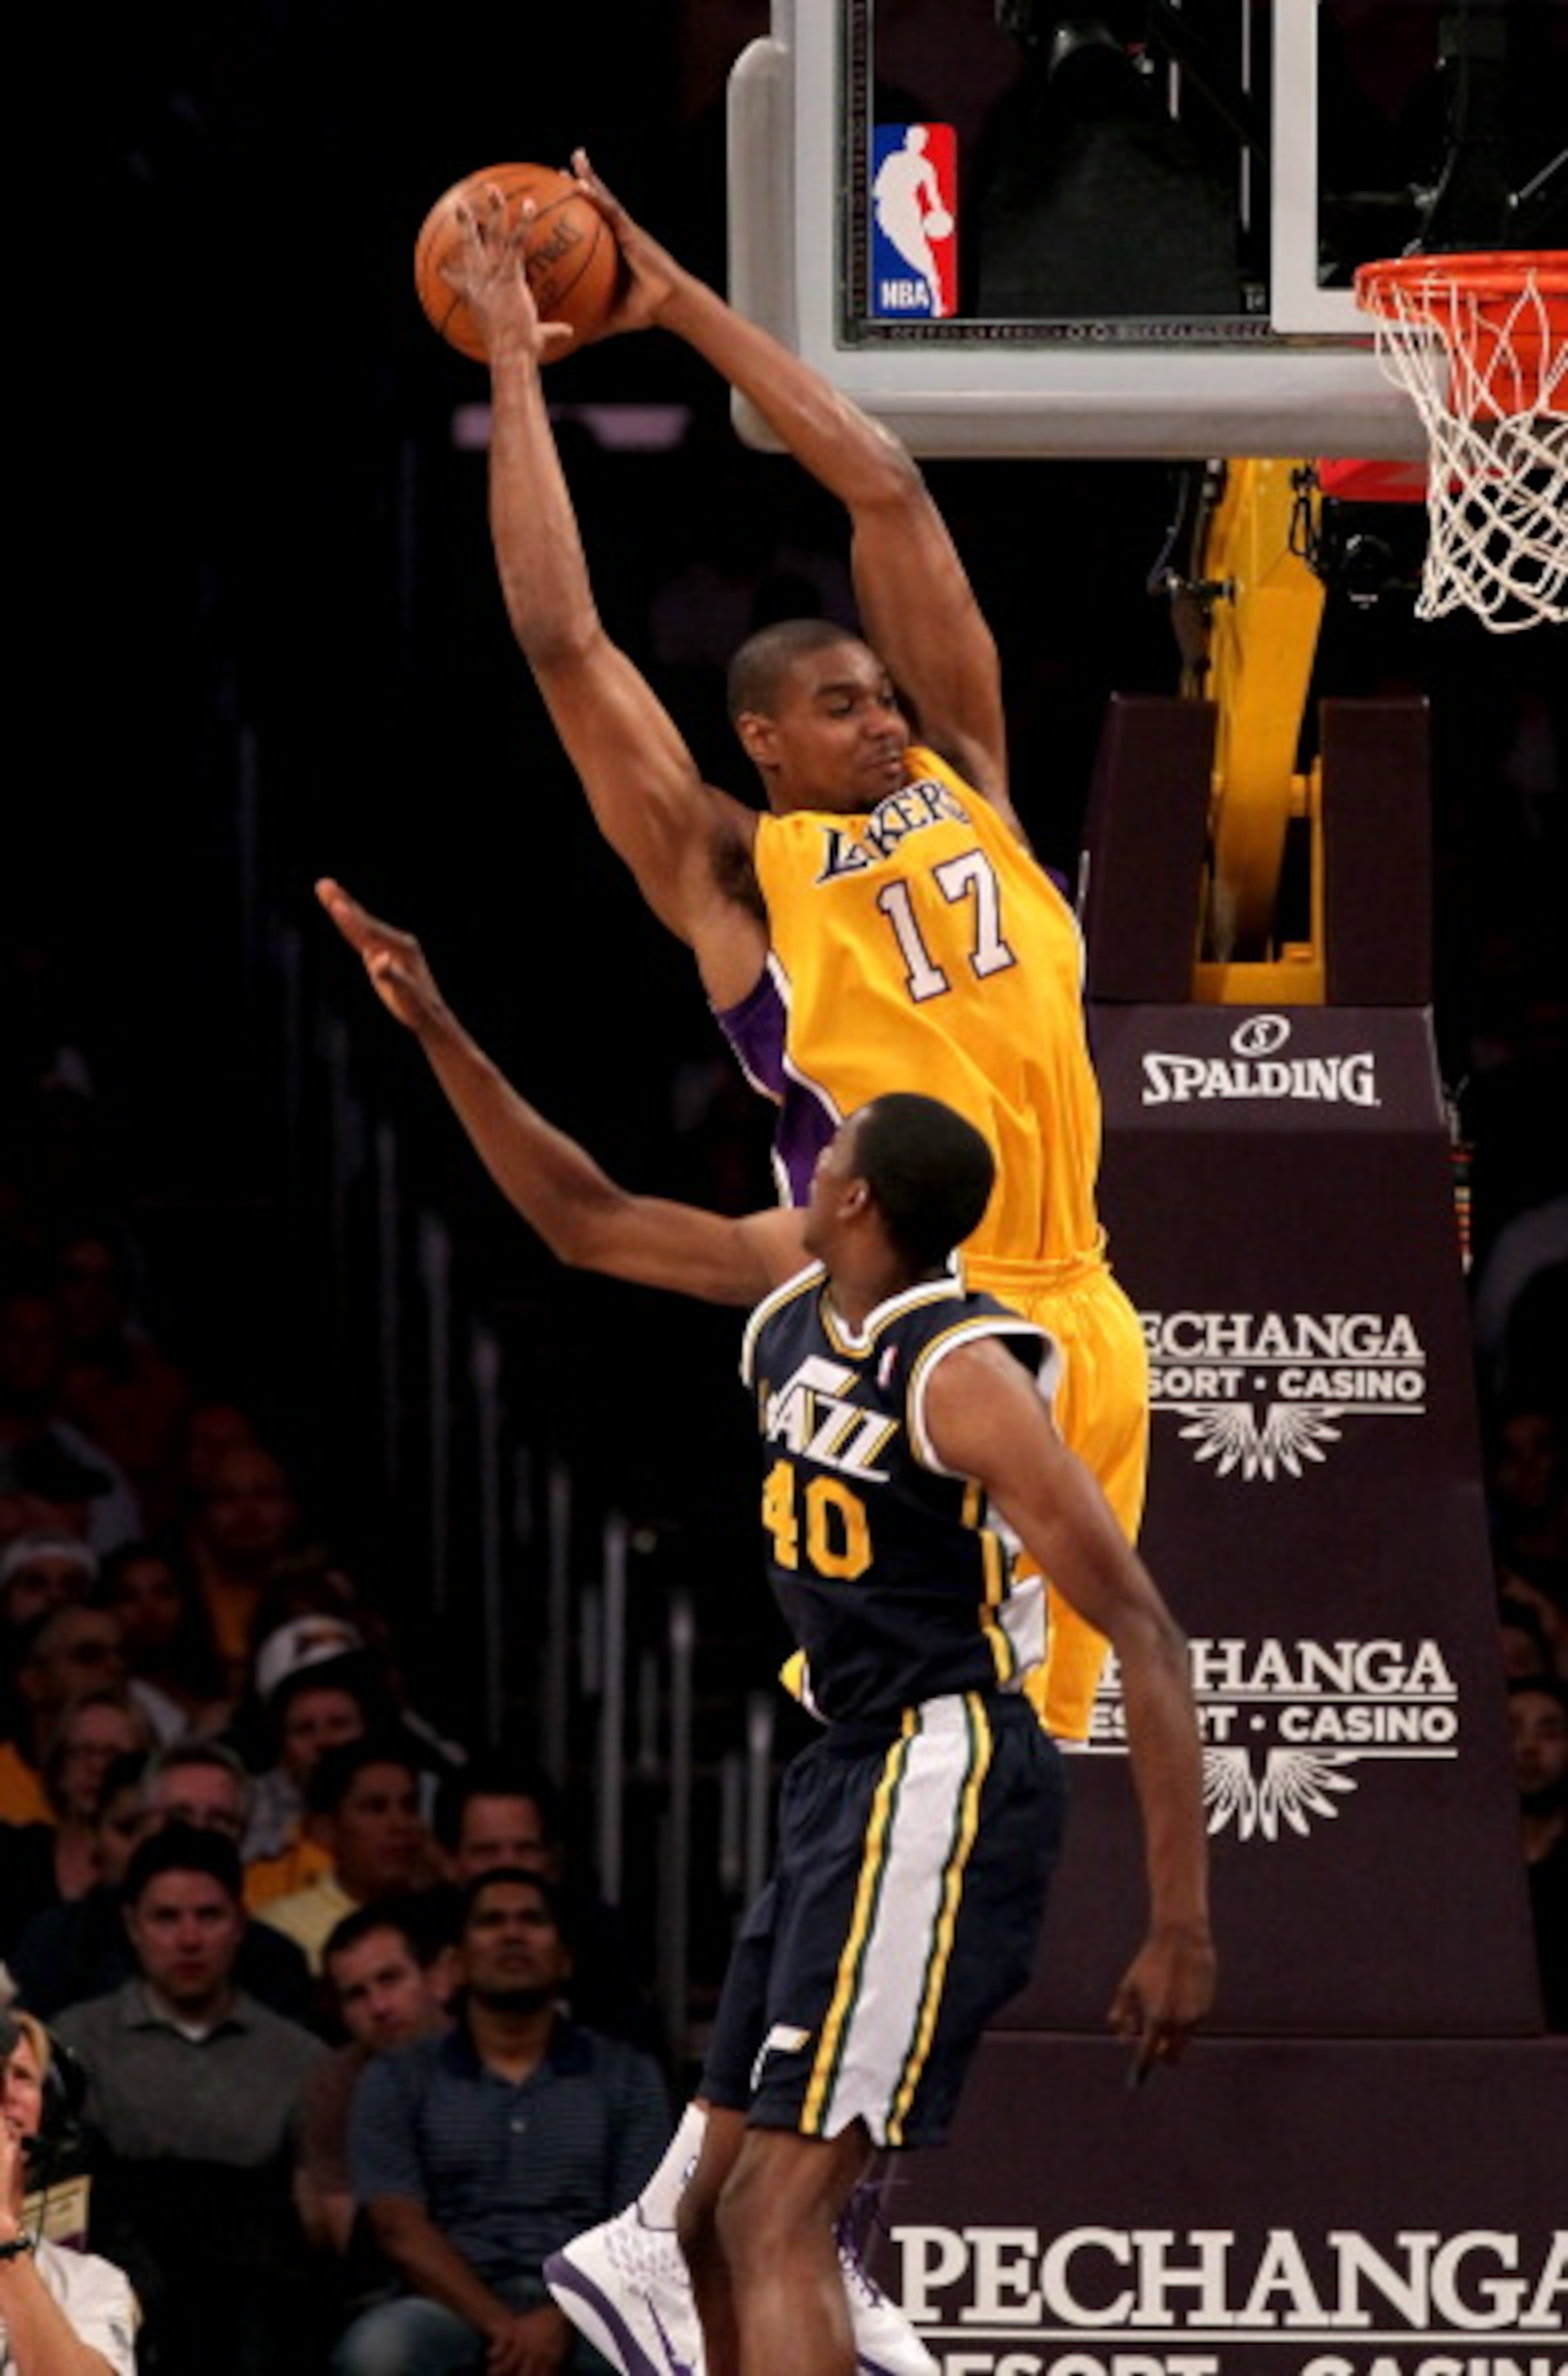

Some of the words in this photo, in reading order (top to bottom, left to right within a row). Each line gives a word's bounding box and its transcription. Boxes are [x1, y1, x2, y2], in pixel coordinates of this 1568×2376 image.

[881, 279, 929, 309] NBA
[876, 847, 1018, 1004] 17
[1143, 1053, 1375, 1106] SPALDING
[1138, 1312, 1425, 1359] ECHANGA
[1148, 1367, 1244, 1398] SORT
[1278, 1369, 1425, 1400] CASINO
[762, 1458, 872, 1581] 40
[1098, 1638, 1458, 1694] HANGA
[1278, 1707, 1458, 1742] CASINO
